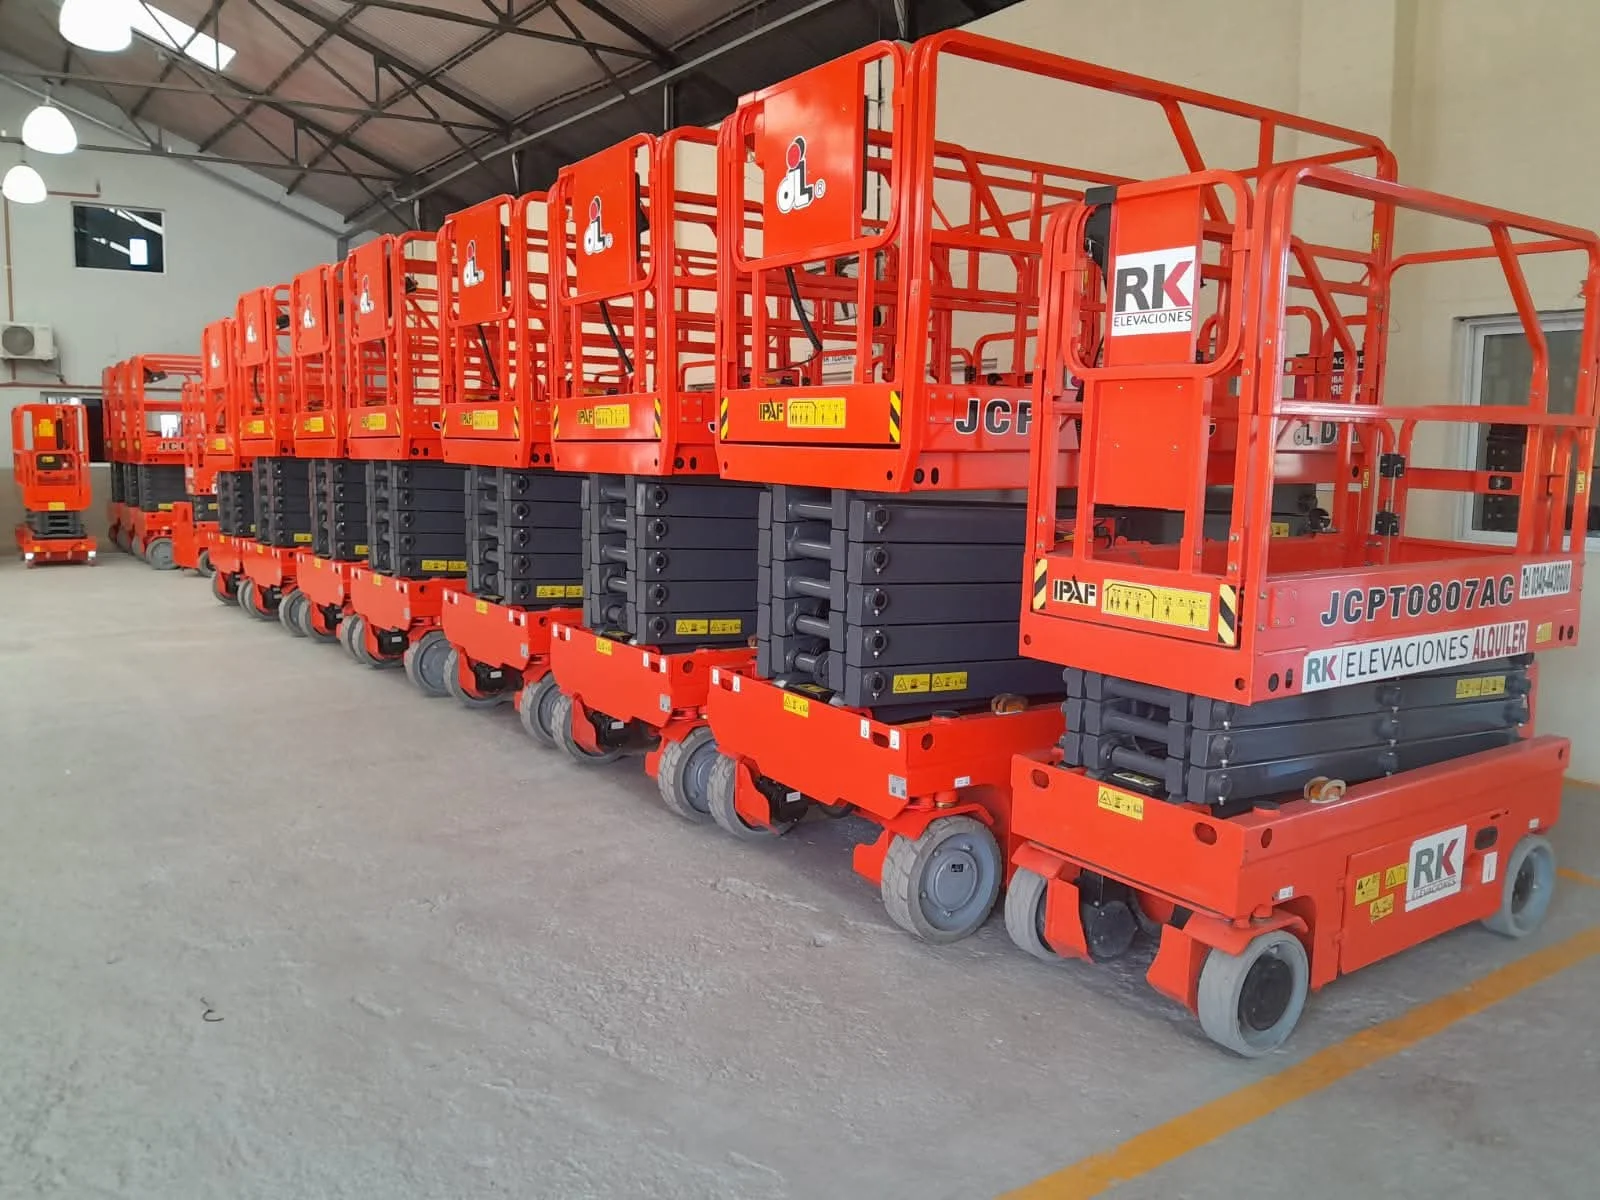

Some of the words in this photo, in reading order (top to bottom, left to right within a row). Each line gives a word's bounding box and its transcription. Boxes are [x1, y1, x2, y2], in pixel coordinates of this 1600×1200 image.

[1115, 260, 1193, 313] RK
[1113, 310, 1192, 327] ELEVACIONES
[759, 397, 783, 421] IPAF
[1053, 575, 1096, 605] IPAF
[1319, 575, 1516, 627] JCPT0807AC
[1306, 654, 1338, 686] RK
[1345, 634, 1469, 678] ELEVACIONES
[1472, 622, 1527, 661] ALQUILER
[1413, 838, 1460, 889] RK
